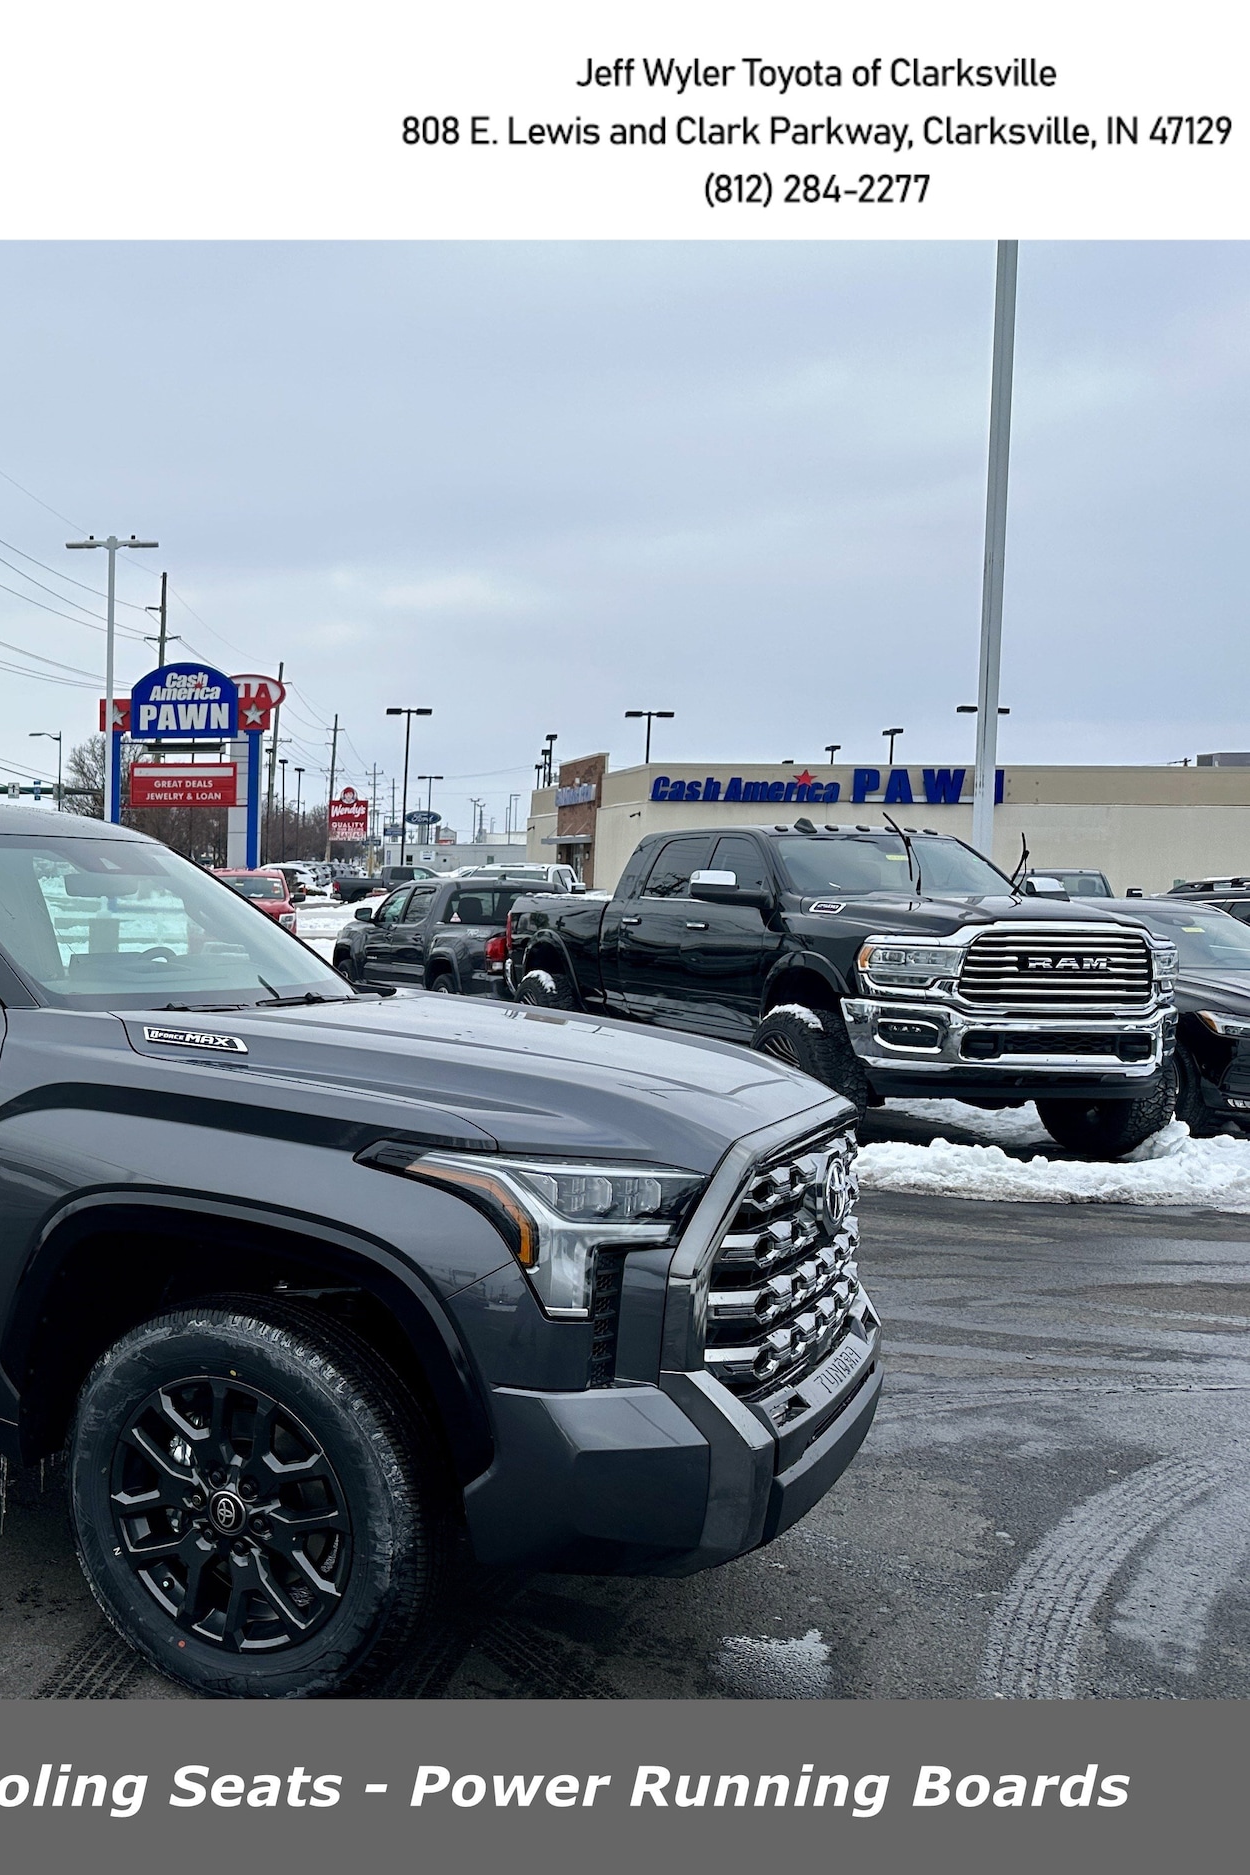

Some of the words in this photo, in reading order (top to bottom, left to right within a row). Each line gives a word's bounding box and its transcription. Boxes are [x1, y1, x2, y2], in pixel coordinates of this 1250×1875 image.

[165, 671, 209, 688] Cash
[149, 686, 221, 701] America
[139, 703, 229, 731] PAWN
[154, 780, 182, 788] GREAT
[185, 780, 213, 788] DEALS
[651, 776, 721, 801] Cash
[723, 777, 841, 804] America
[186, 792, 193, 800] &
[331, 803, 366, 818] Wendy's
[1028, 957, 1107, 970] RAM
[184, 1033, 230, 1047] MAX
[813, 1346, 862, 1394] TUNDRA
